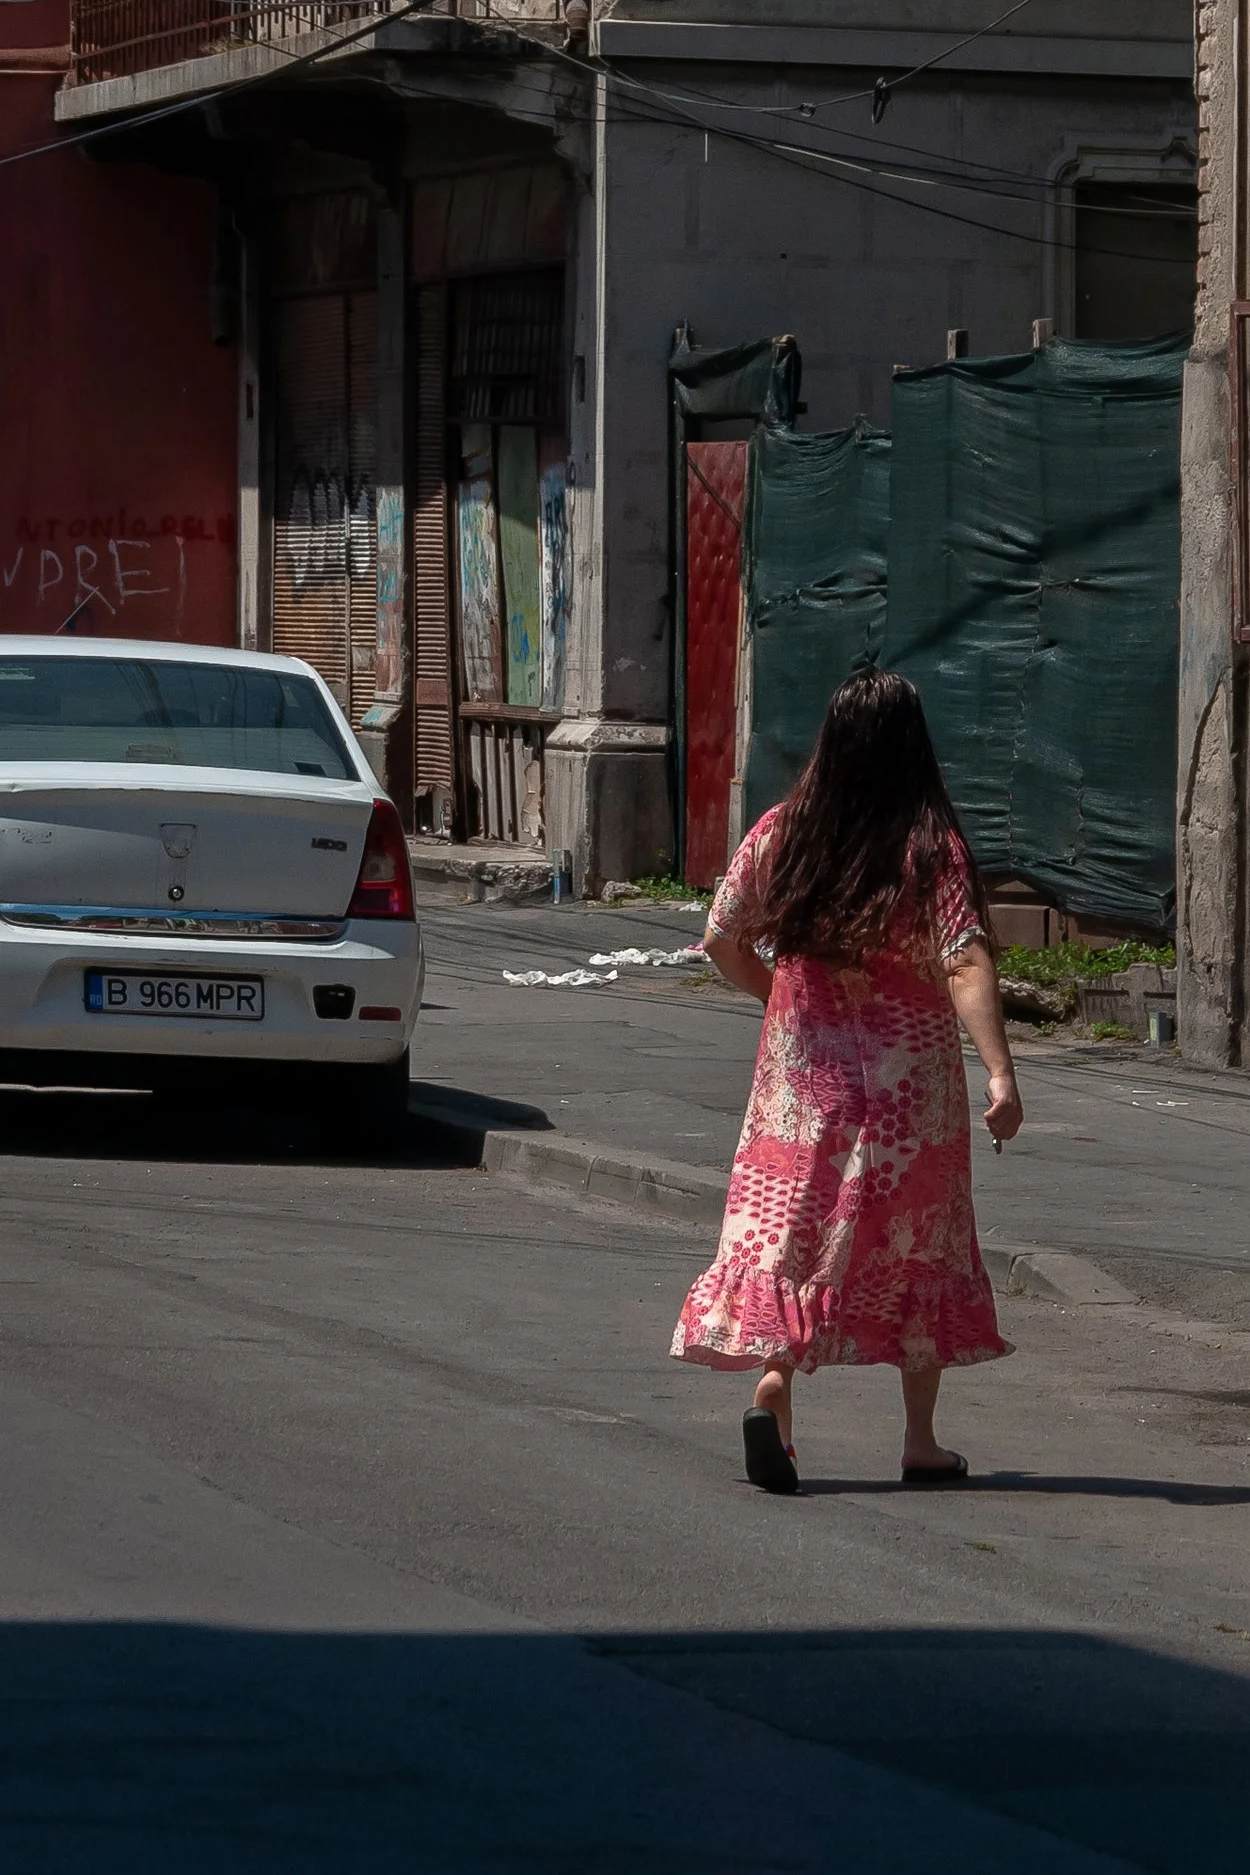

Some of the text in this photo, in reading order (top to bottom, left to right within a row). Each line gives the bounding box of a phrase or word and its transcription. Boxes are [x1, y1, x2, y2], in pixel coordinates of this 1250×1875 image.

[107, 978, 256, 1012] B 966 MPR
